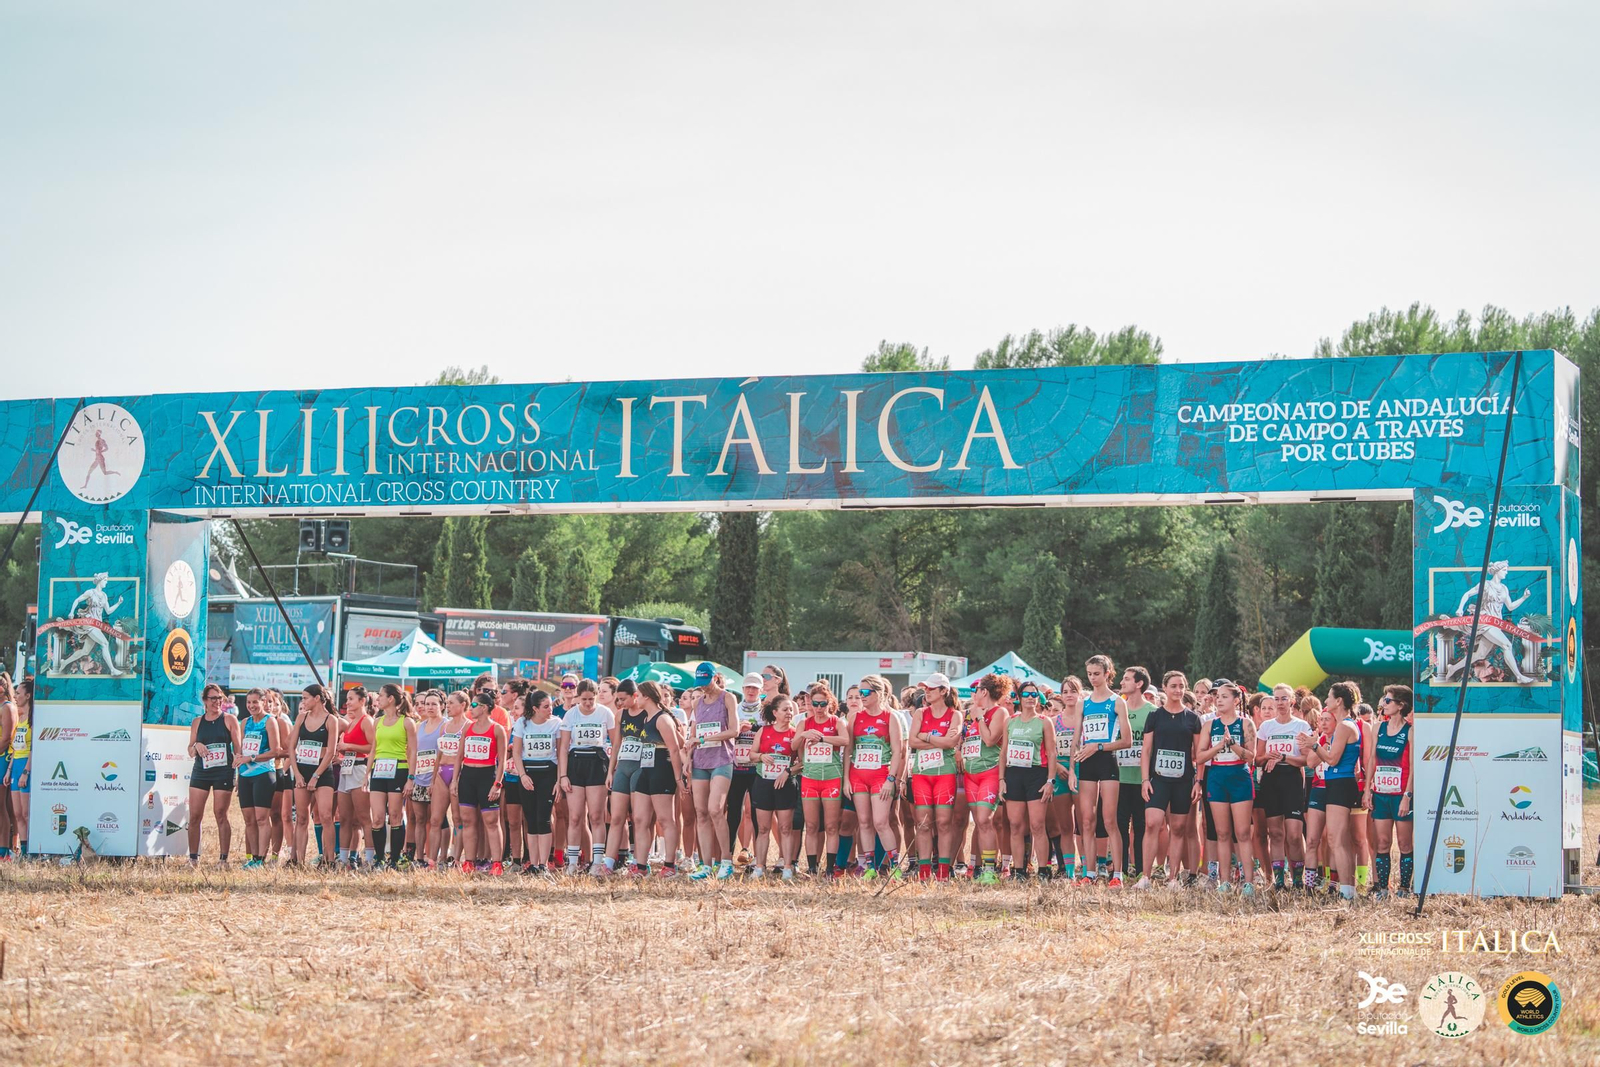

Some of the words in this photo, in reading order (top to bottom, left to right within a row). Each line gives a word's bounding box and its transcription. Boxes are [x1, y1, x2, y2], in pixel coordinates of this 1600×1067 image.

[1177, 401, 1336, 423] CAMPEONATO
[1341, 400, 1371, 419] DE
[1375, 393, 1518, 418] ANDALUCÍA
[65, 408, 138, 446] ITÁLICA
[615, 376, 1024, 479] ITÁLICA
[1229, 424, 1258, 443] DE
[1262, 421, 1348, 442] CAMPO
[1352, 421, 1371, 440] A
[1374, 416, 1464, 439] TRAVÉS
[197, 404, 383, 480] XLIII
[387, 401, 542, 448] CROSS
[1281, 443, 1327, 463] POR
[1331, 441, 1415, 461] CLUBES
[388, 448, 600, 475] INTERNACIONAL
[195, 483, 371, 505] INTERNATIONAL
[377, 481, 446, 503] CROSS
[450, 479, 560, 501] COUNTRY
[95, 524, 134, 533] Diputación
[95, 532, 134, 544] Sevilla
[476, 621, 495, 630] ARCOS
[503, 622, 518, 631] META
[544, 624, 556, 632] LED
[1414, 621, 1438, 635] CROSS
[1084, 722, 1106, 732] 1317
[578, 730, 602, 738] 1439
[440, 741, 458, 750] 1423
[466, 744, 488, 754] 1168
[528, 742, 551, 750] 1438
[620, 744, 641, 754] 1527
[962, 744, 980, 756] 1306
[1269, 744, 1292, 753] 1120
[299, 748, 318, 758] 1501
[808, 746, 832, 756] 1258
[1009, 750, 1032, 761] 1261
[1118, 750, 1142, 759] 1146
[206, 752, 225, 762] 1337
[858, 753, 880, 762] 1281
[920, 752, 942, 764] 1349
[375, 763, 394, 772] 1217
[416, 758, 436, 769] 1293
[764, 764, 788, 772] 1257
[1159, 759, 1182, 770] 1103
[1377, 776, 1400, 786] 1460
[94, 782, 126, 792] Andalucía
[1500, 810, 1543, 822] Andalucía
